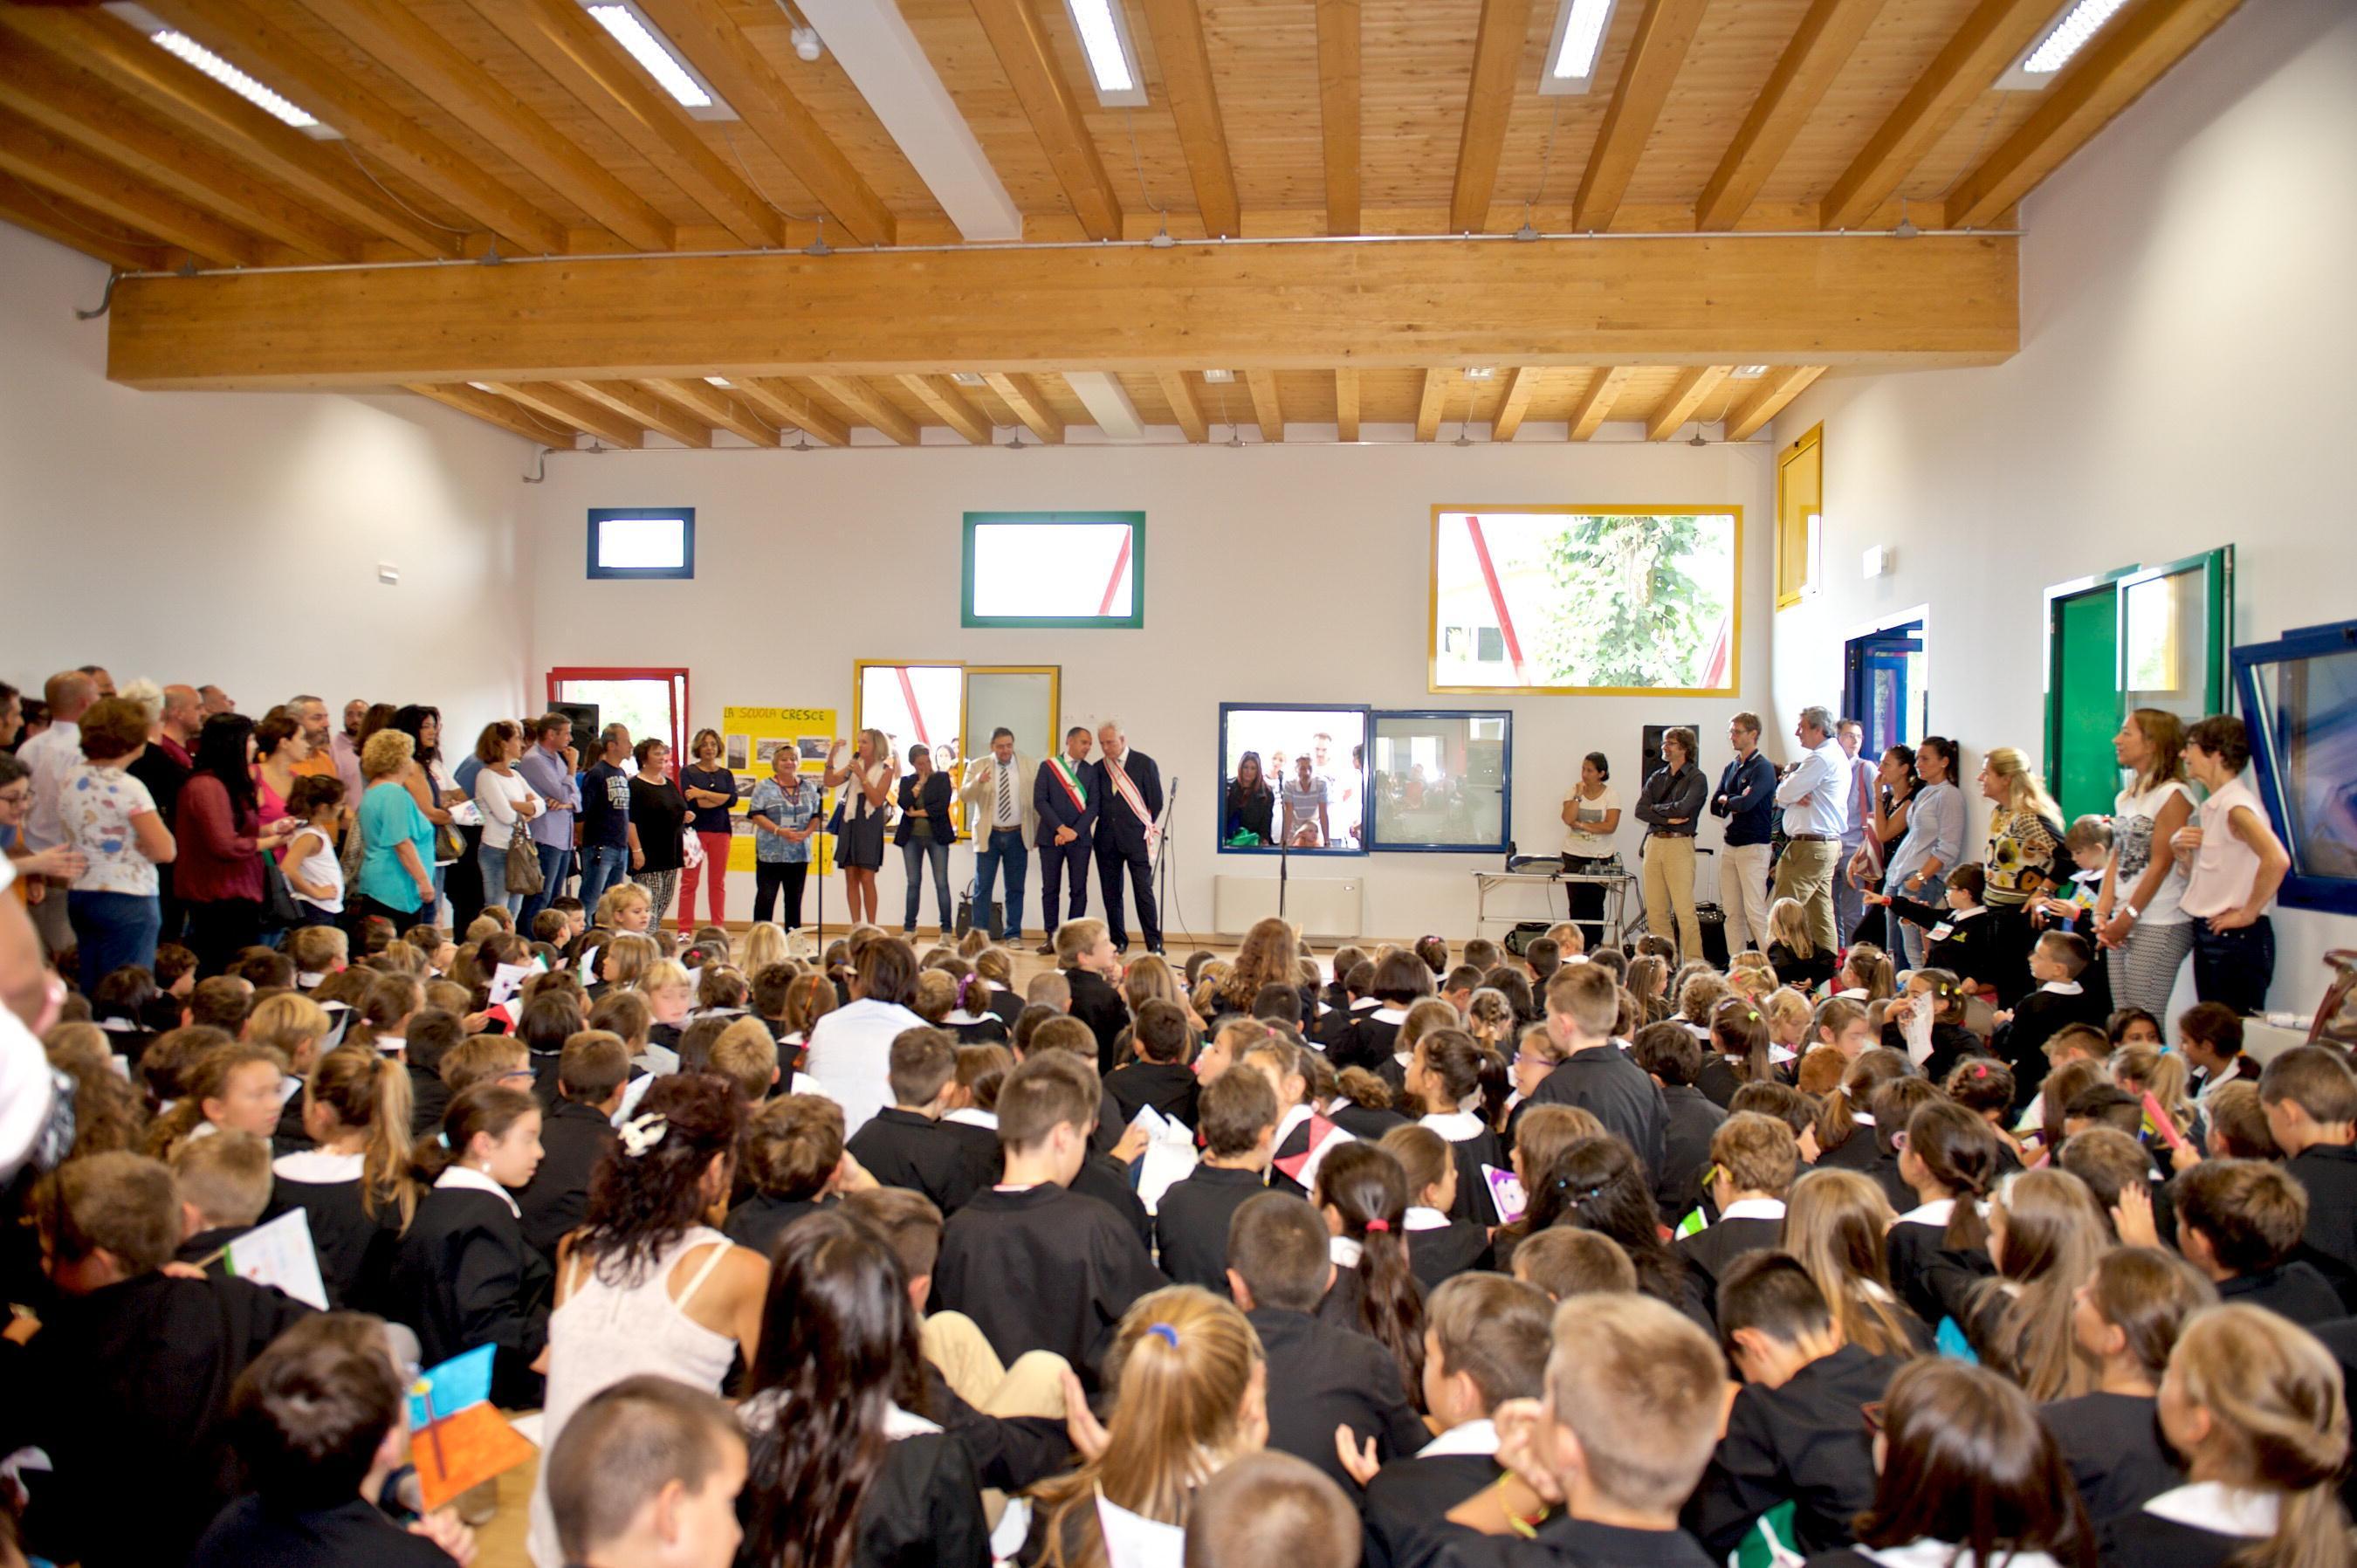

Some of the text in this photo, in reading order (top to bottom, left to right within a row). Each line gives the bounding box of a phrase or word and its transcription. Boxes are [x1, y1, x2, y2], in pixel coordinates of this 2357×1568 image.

[724, 707, 824, 720] LA SCUOLA CRESCE
